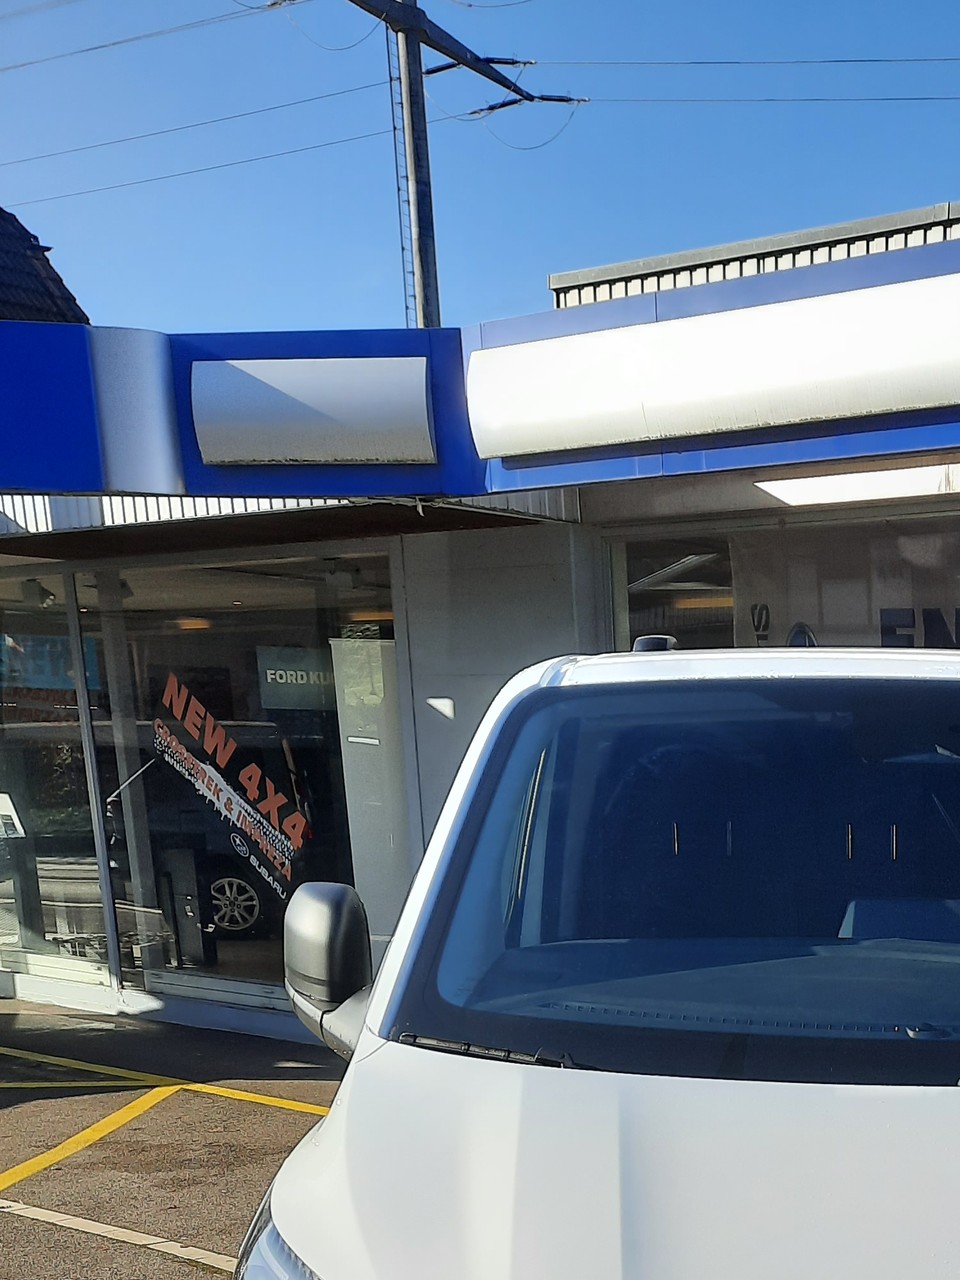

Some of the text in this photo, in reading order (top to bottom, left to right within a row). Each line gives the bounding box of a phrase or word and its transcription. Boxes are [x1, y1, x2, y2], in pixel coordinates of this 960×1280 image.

[266, 669, 335, 685] FORD KU
[162, 671, 307, 851] NEW 4X4
[236, 810, 293, 882] IMPREZA
[250, 854, 287, 900] SUBARU
